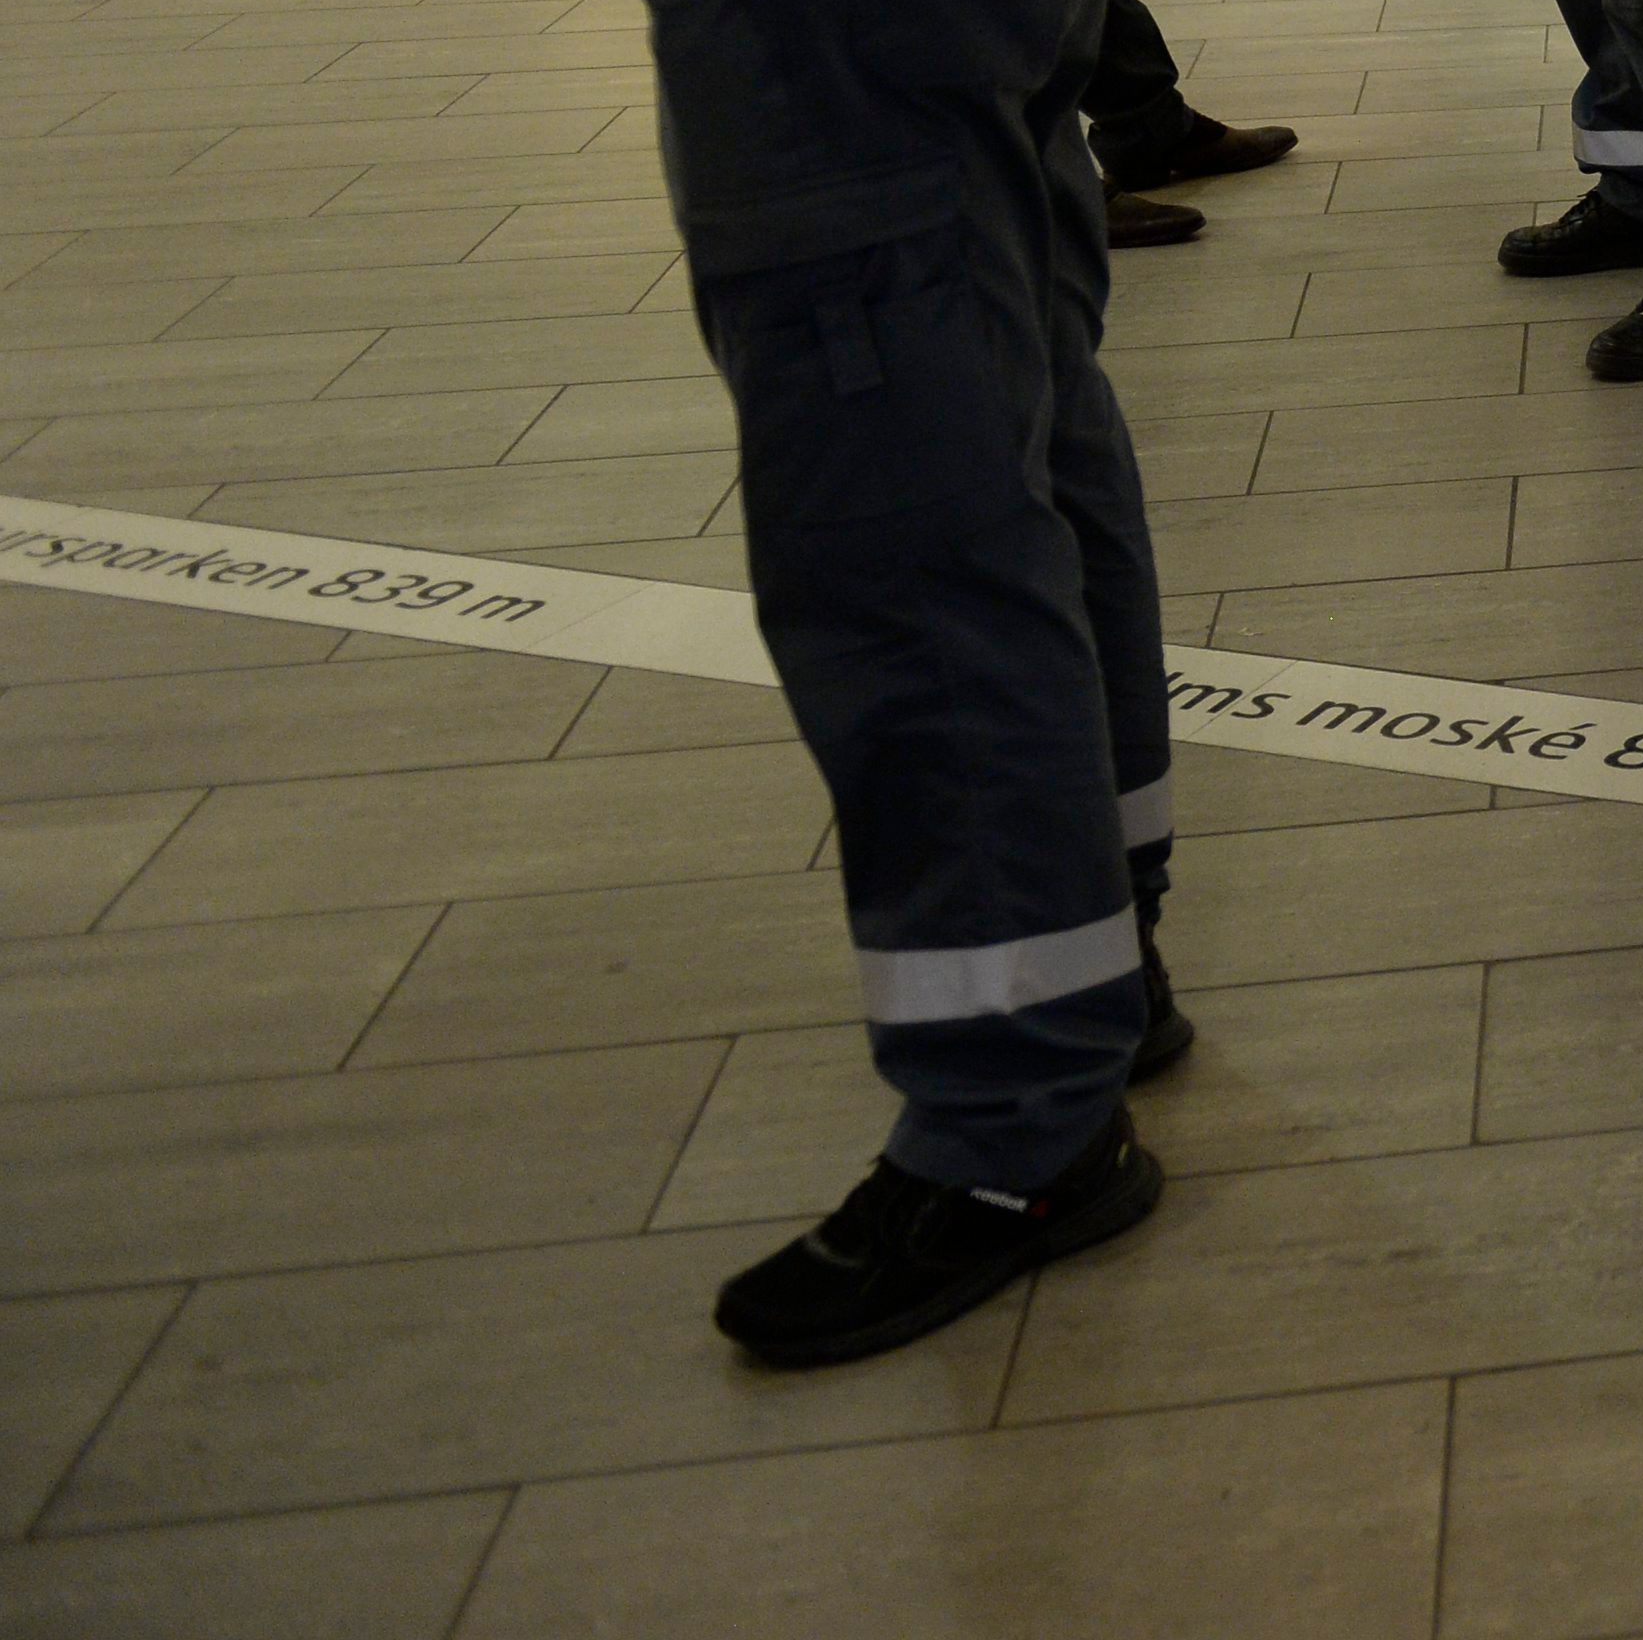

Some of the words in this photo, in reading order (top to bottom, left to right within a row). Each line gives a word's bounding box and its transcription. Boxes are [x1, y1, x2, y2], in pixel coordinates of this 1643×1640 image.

[306, 568, 475, 610] 839
[458, 592, 547, 622] m
[1296, 698, 1590, 760] moské
